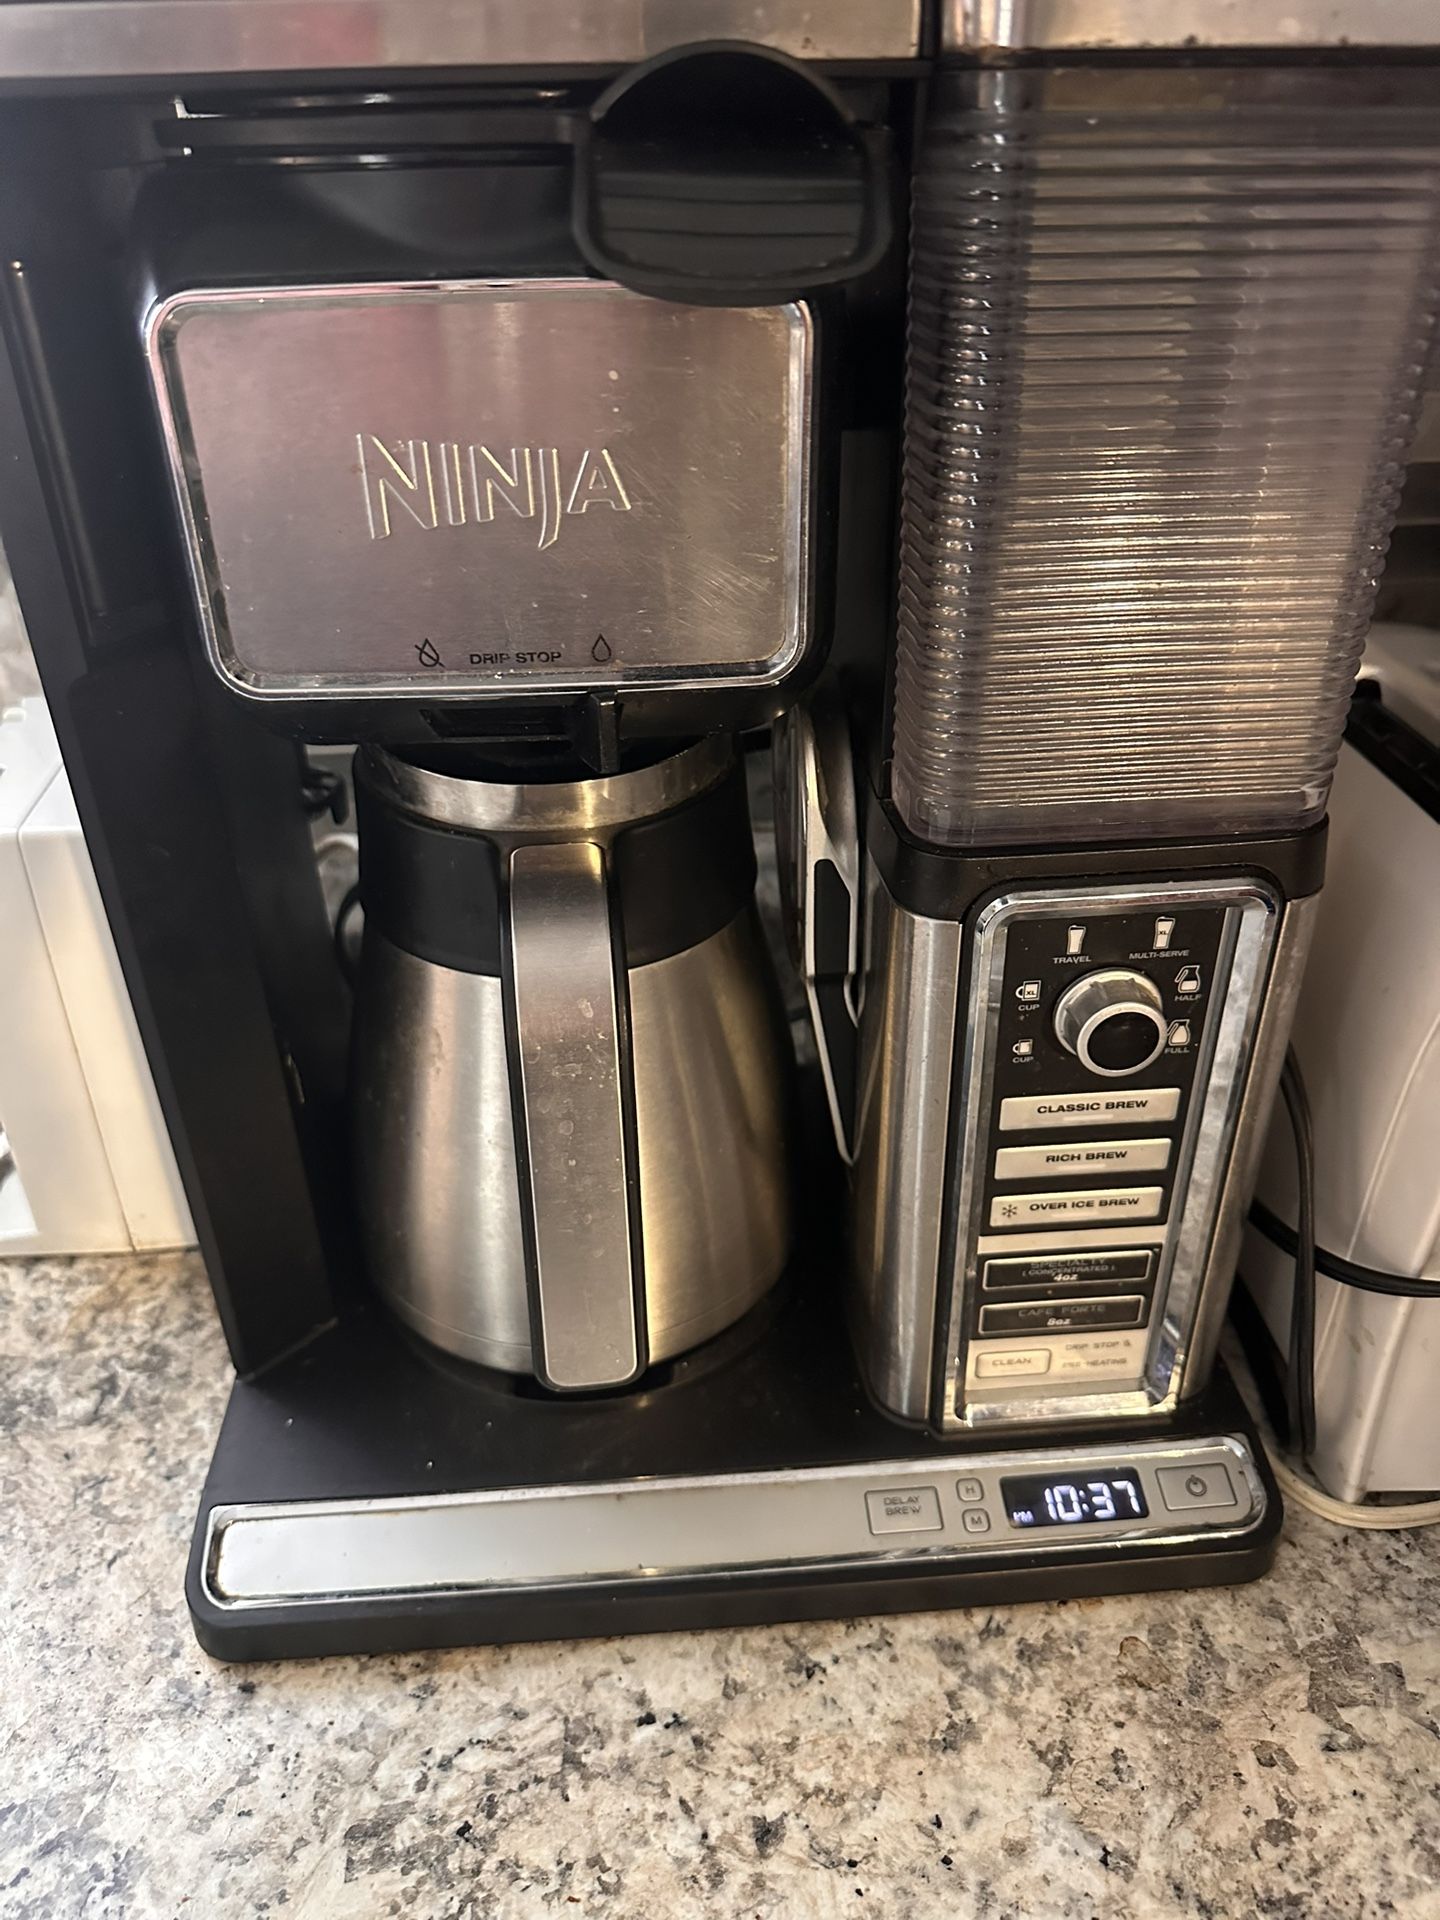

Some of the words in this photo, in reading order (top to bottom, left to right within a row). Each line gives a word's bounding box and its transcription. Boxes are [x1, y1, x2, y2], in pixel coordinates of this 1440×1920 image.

[356, 433, 632, 550] NINJA
[469, 653, 511, 665] DRIP
[515, 651, 562, 664] STOP
[1128, 950, 1190, 960] MULTI-SERVE
[1053, 956, 1092, 964] TRAVEL
[1174, 994, 1202, 1002] HALF
[1018, 1003, 1040, 1012] CUP
[1012, 1056, 1034, 1064] CUP
[1037, 1102, 1100, 1114] CLASSIC
[1105, 1100, 1148, 1110] BREW
[1045, 1154, 1081, 1163] RICH
[1085, 1151, 1127, 1160] BREW
[1029, 1202, 1067, 1211] OVER
[1098, 1198, 1140, 1207] BREW
[1061, 1304, 1106, 1313] FORTE
[1047, 1317, 1072, 1326] 8oz
[991, 1357, 1031, 1366] CLEAN
[965, 1485, 975, 1494] H
[884, 1495, 920, 1506] DELAY
[1044, 1480, 1140, 1521] 10:37
[885, 1504, 921, 1516] BREW
[970, 1516, 982, 1525] M
